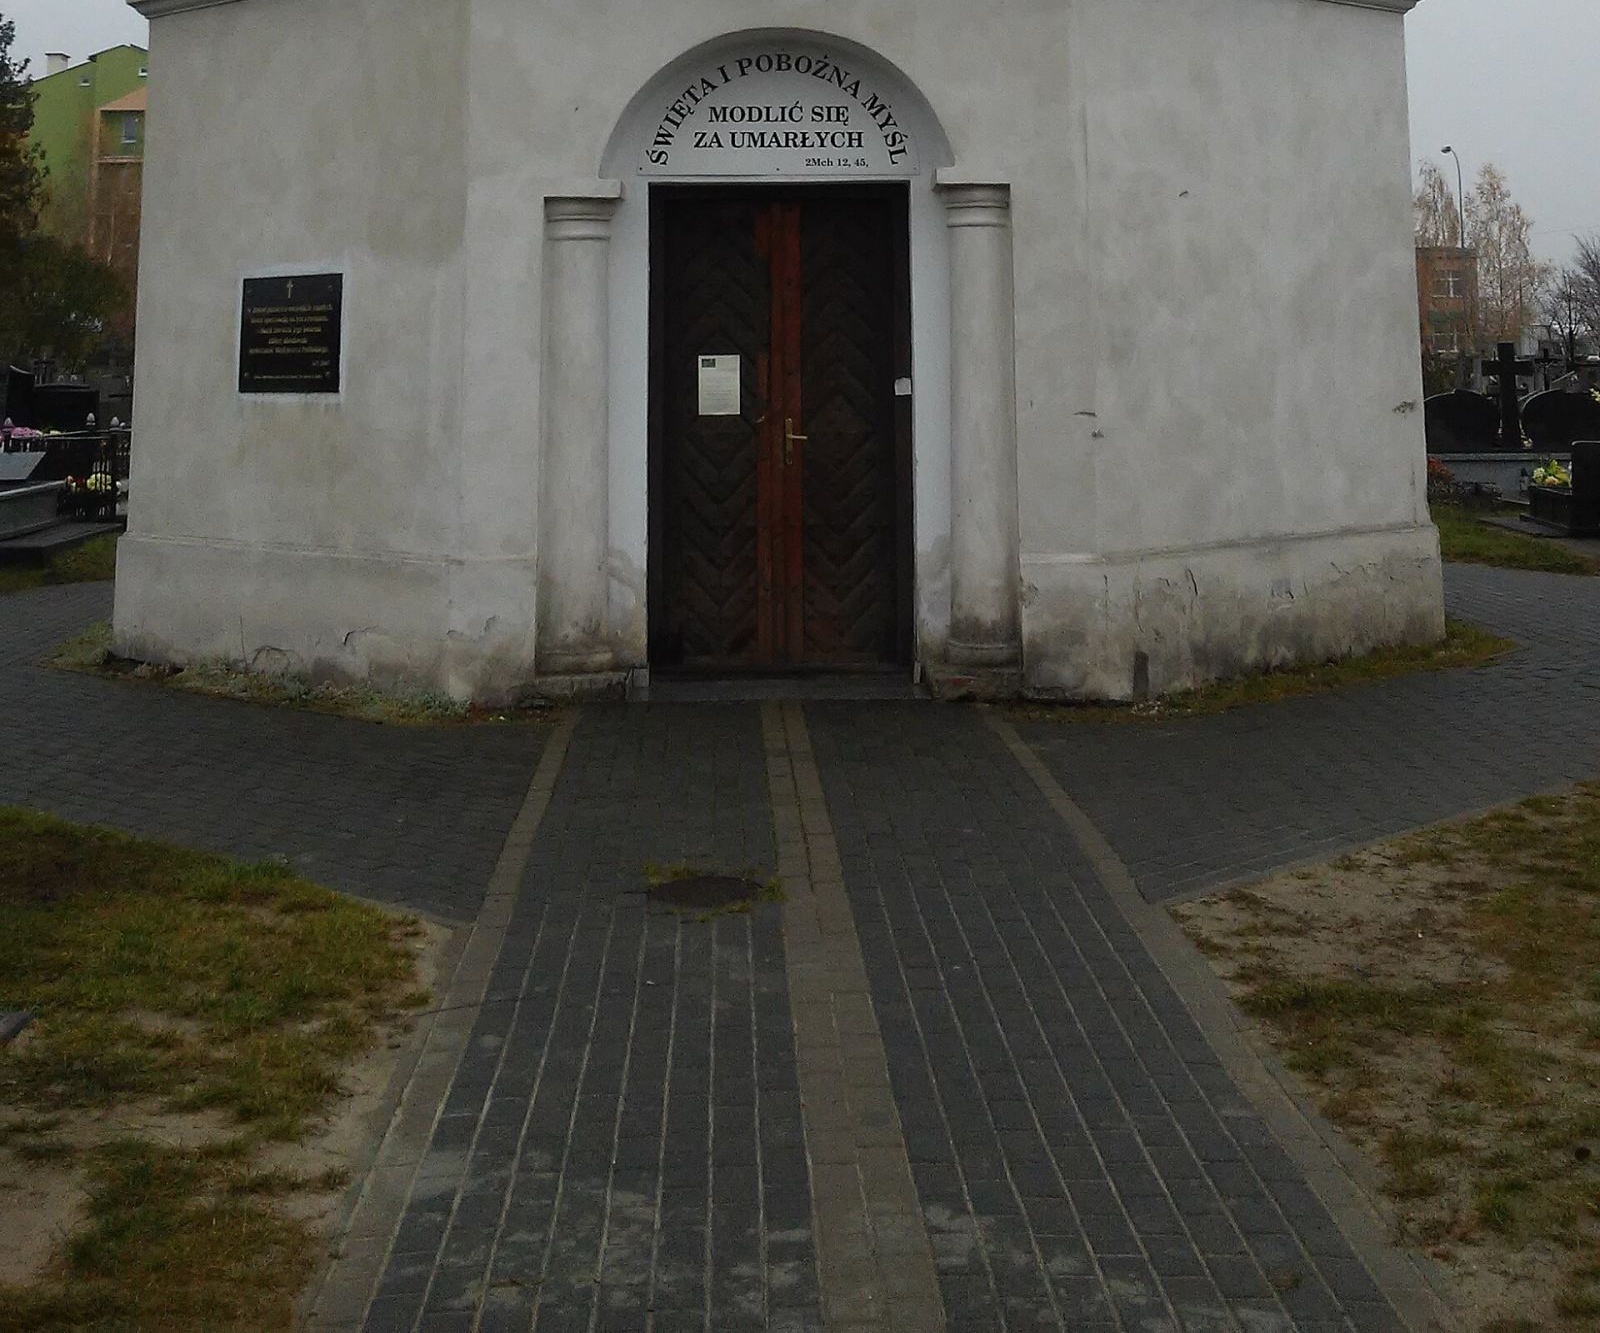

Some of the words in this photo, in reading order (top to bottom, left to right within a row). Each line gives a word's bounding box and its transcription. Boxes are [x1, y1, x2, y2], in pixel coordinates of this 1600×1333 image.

[646, 77, 719, 166] ŚWIĘTA
[717, 64, 732, 84] I
[736, 53, 861, 100] POBOŻNA
[861, 92, 908, 165] MYŚL
[708, 100, 804, 123] MODLIĆ
[811, 105, 849, 126] SIĘ
[693, 131, 724, 148] ZA
[729, 131, 864, 148] UMARŁYCH
[805, 157, 833, 167] 2Mch
